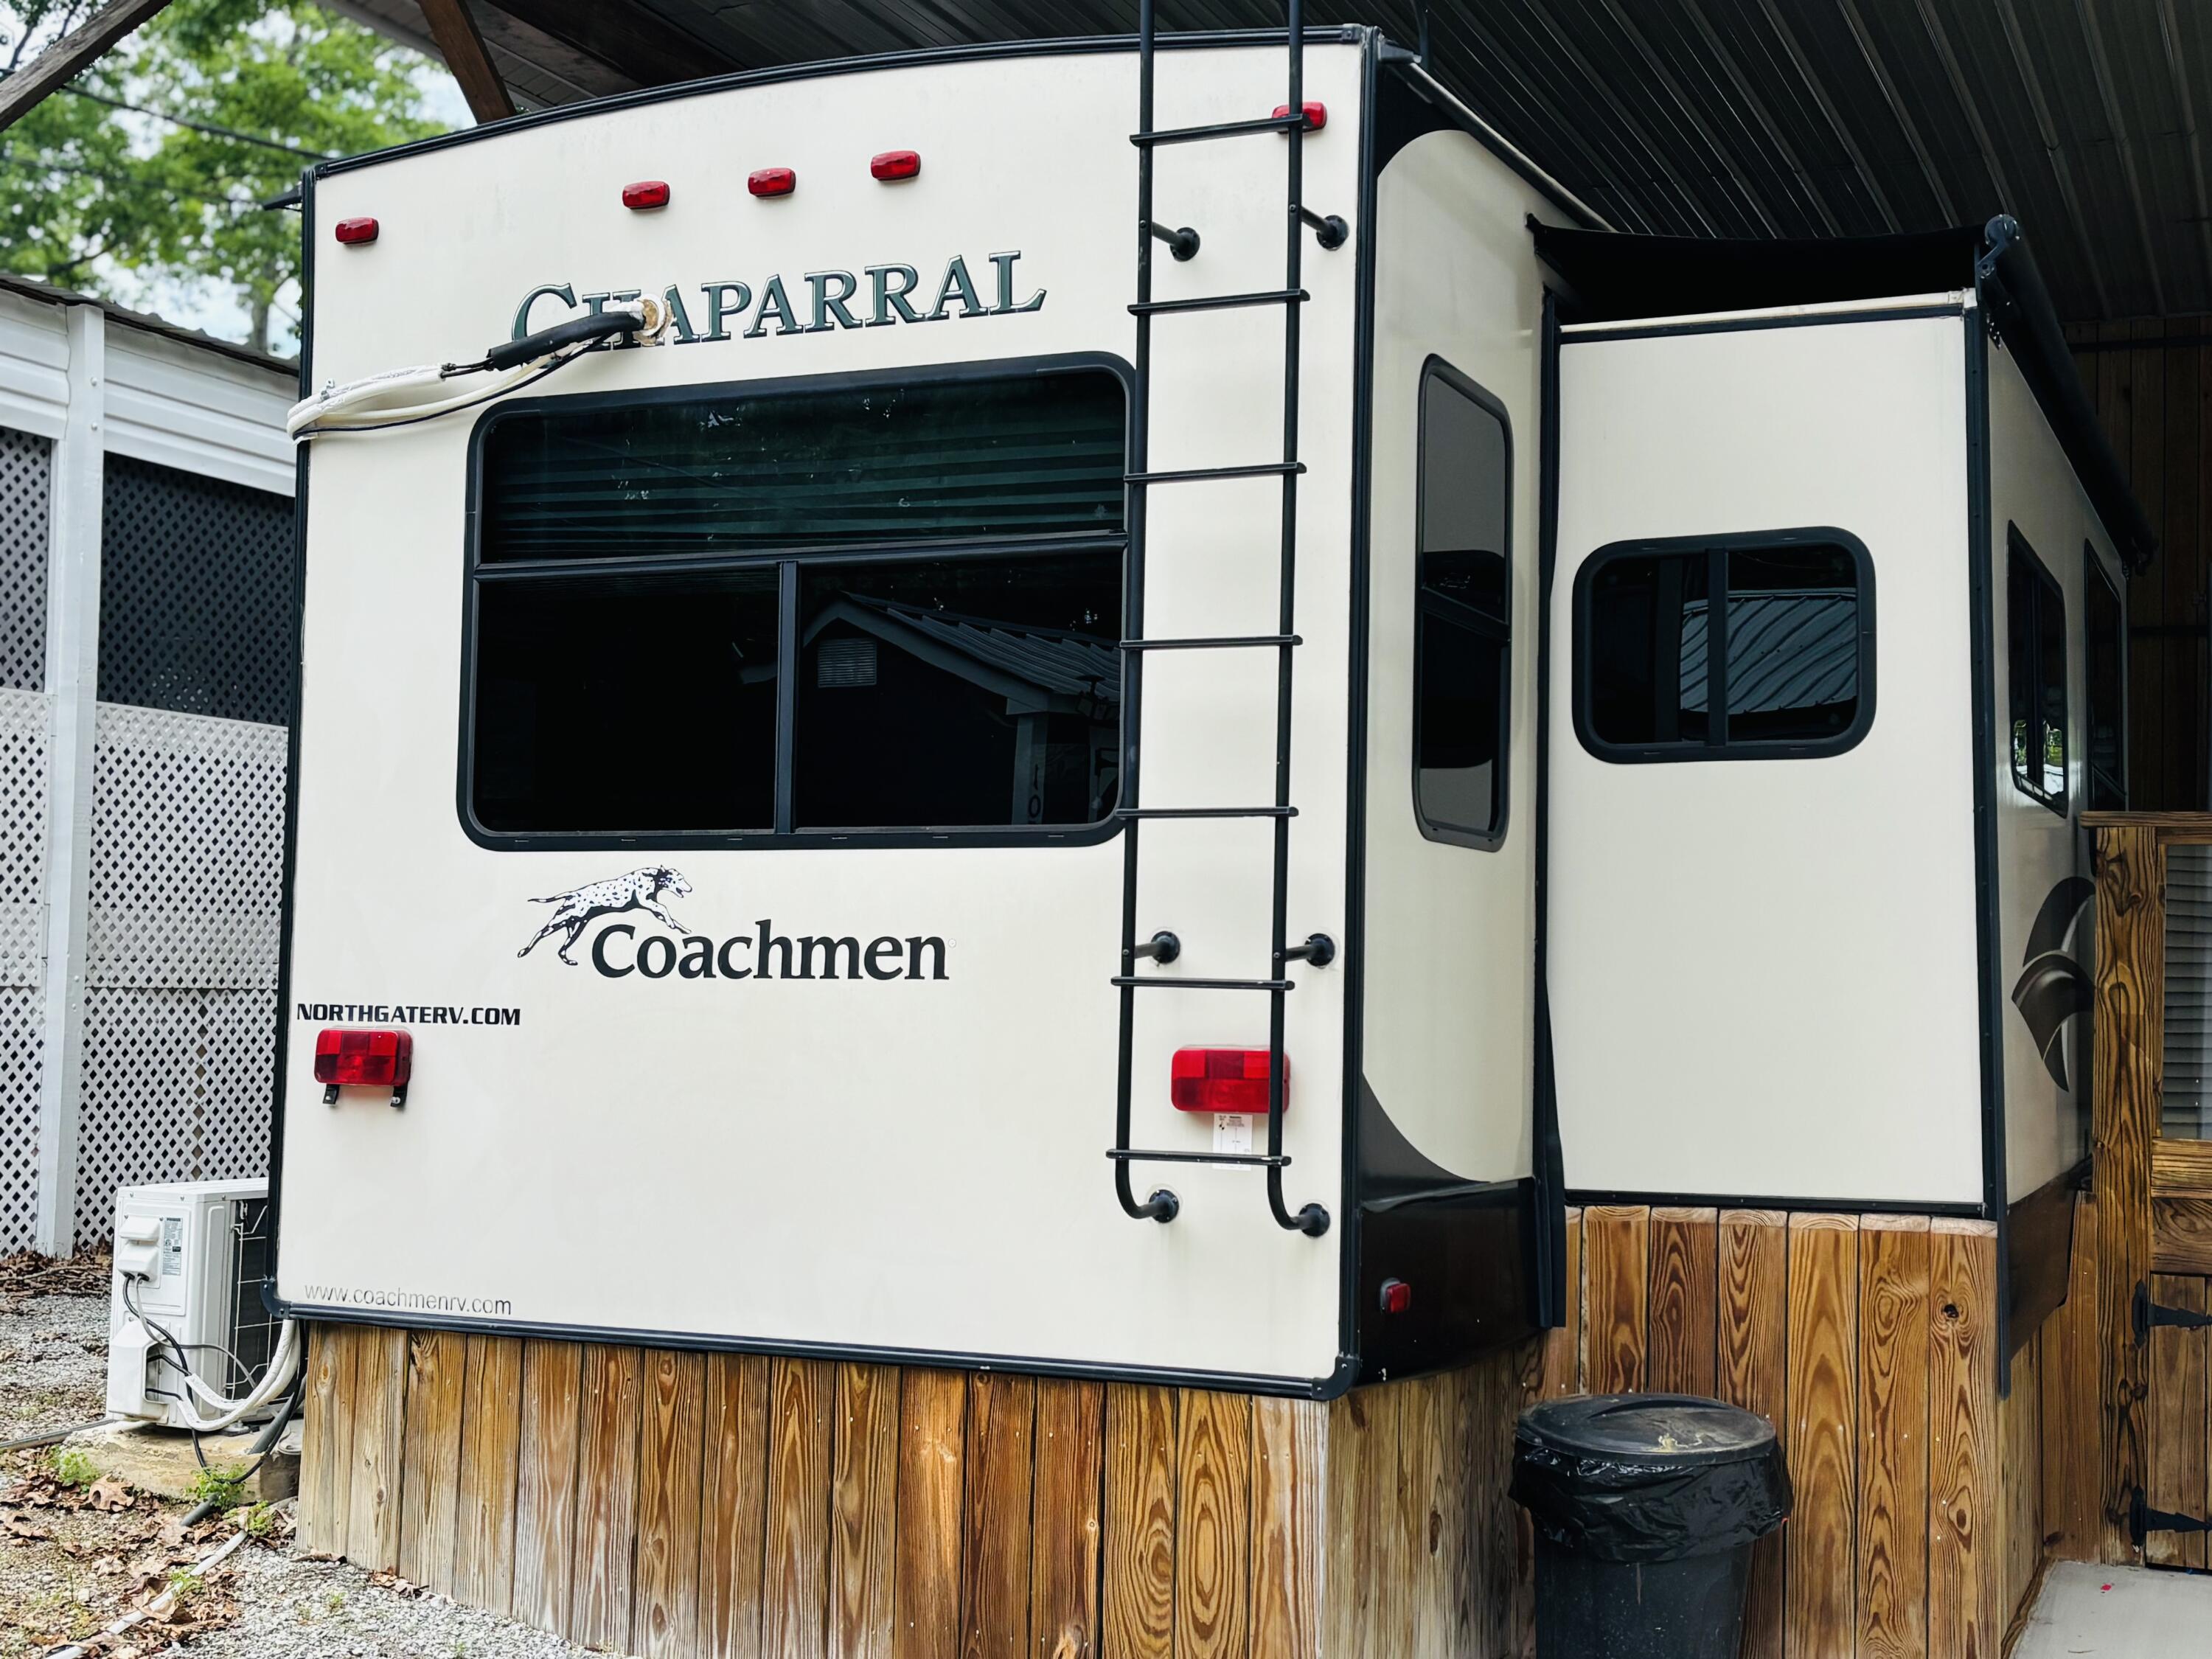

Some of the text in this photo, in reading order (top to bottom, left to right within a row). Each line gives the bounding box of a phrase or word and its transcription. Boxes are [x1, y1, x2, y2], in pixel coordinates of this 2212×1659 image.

[592, 919, 950, 980] Coachmen
[297, 1004, 521, 1026] NORTHGATERV.COM
[305, 1284, 512, 1315] www.coachmenrv.com
